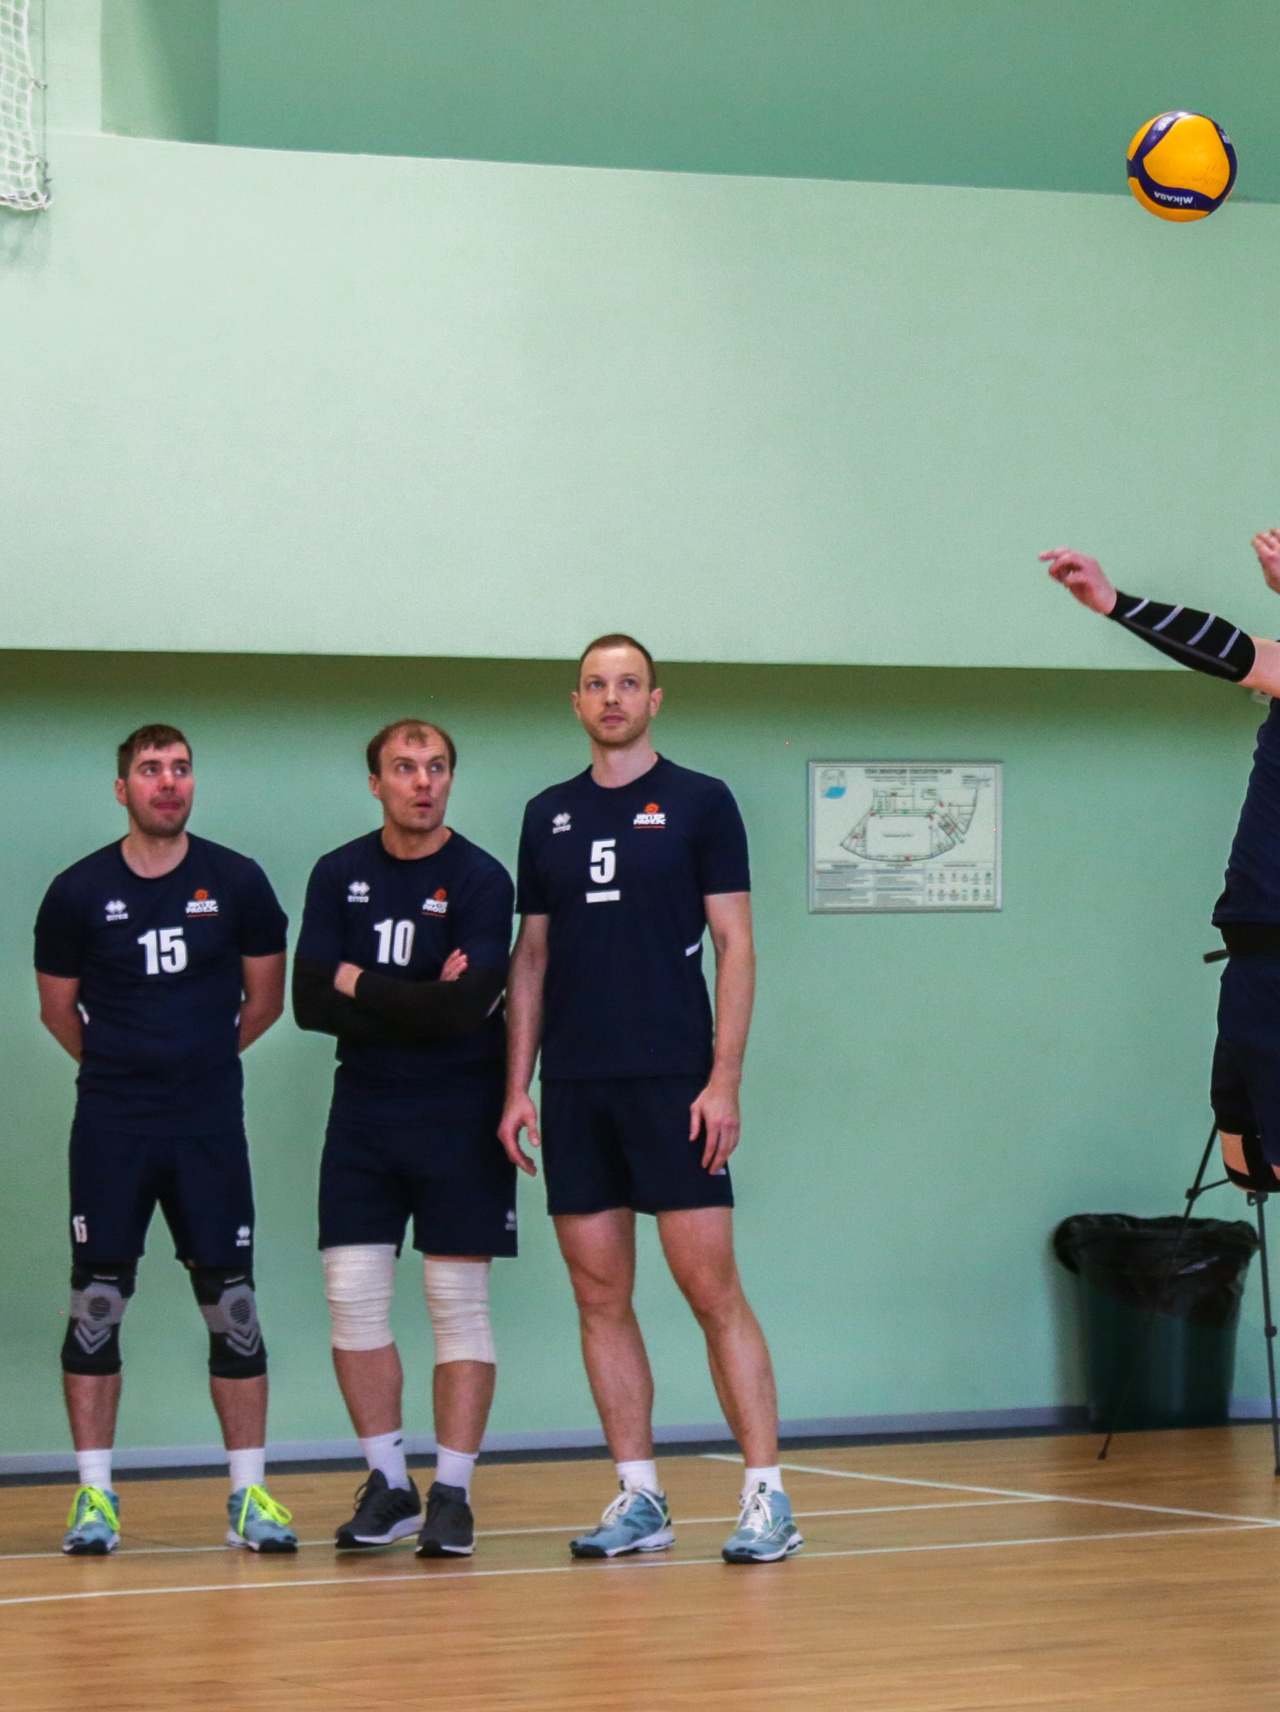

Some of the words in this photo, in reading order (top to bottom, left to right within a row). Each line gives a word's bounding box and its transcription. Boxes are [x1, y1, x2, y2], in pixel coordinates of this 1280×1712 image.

[590, 839, 617, 884] 5
[137, 926, 188, 975] 15
[373, 918, 416, 967] 10
